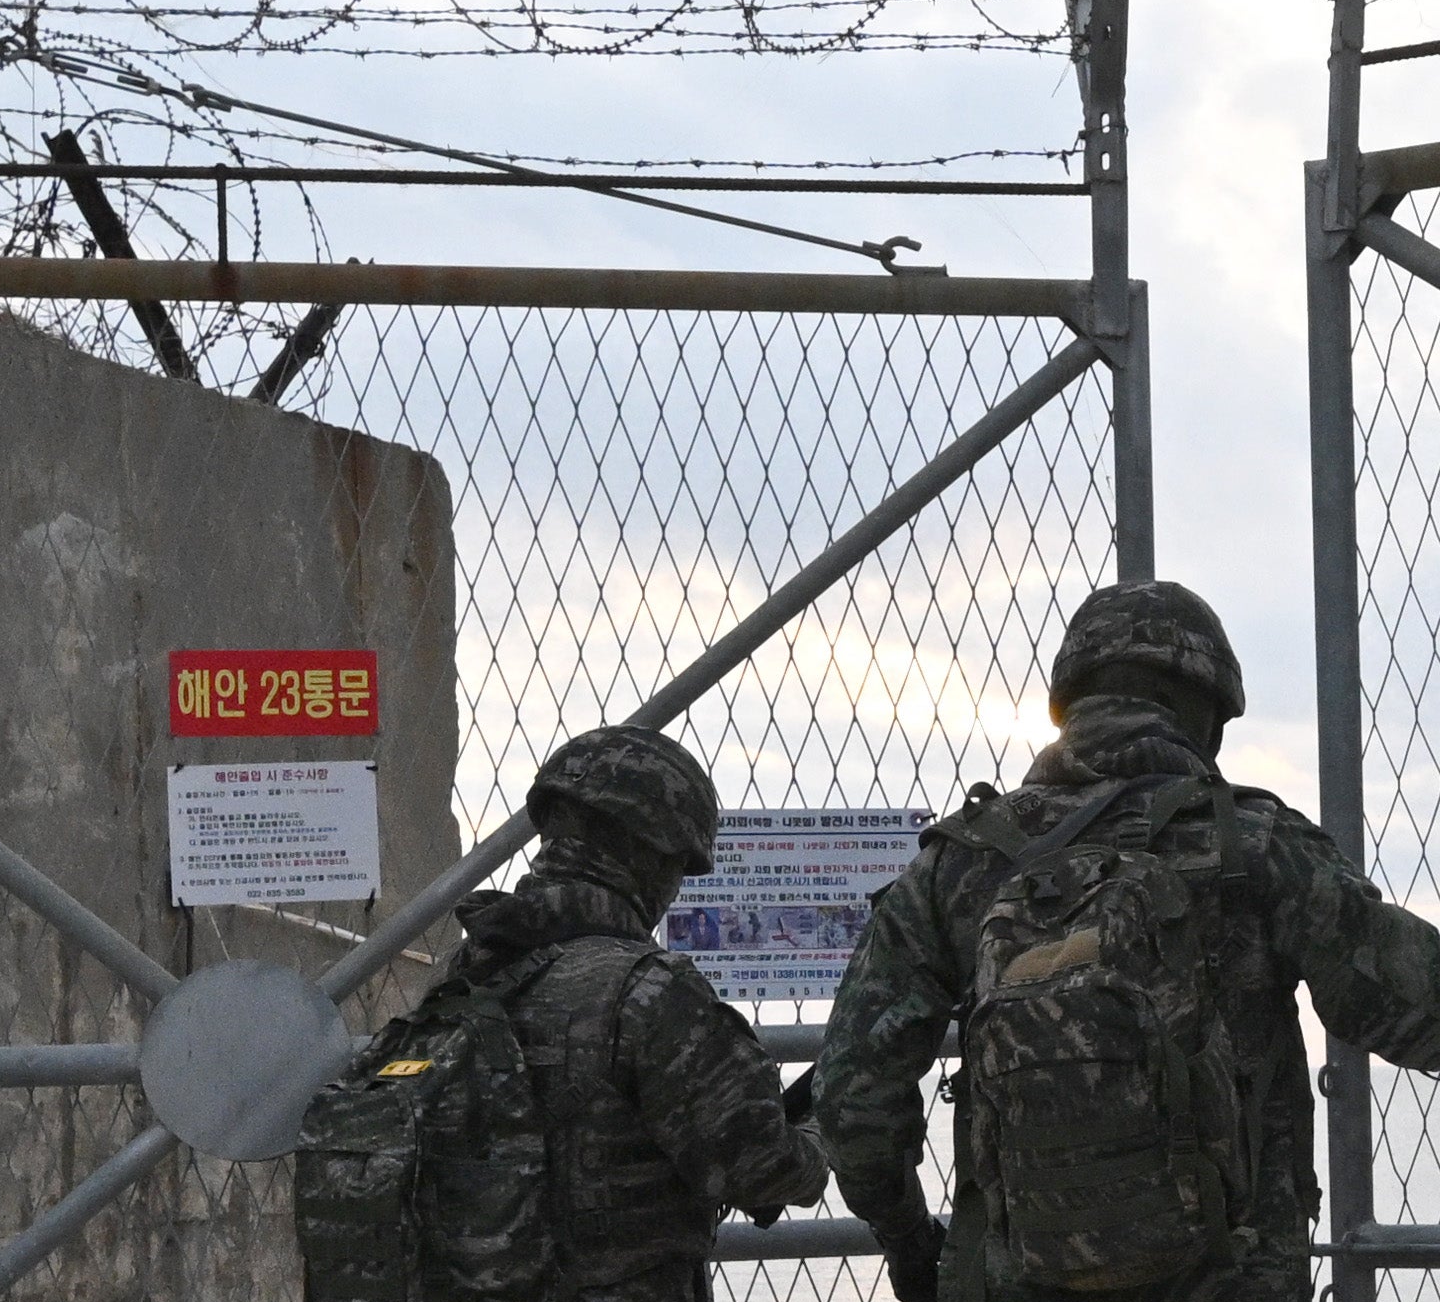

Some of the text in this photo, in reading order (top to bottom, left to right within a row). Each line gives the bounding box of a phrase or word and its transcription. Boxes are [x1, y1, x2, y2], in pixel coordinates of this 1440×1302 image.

[177, 669, 370, 718] 해안 23통문
[282, 768, 329, 781] 준수사항
[821, 815, 854, 827] 발견시
[858, 815, 902, 827] 안전수칙
[754, 865, 771, 874] 지뢰
[774, 865, 800, 874] 발견시
[732, 970, 769, 980] 국번없이
